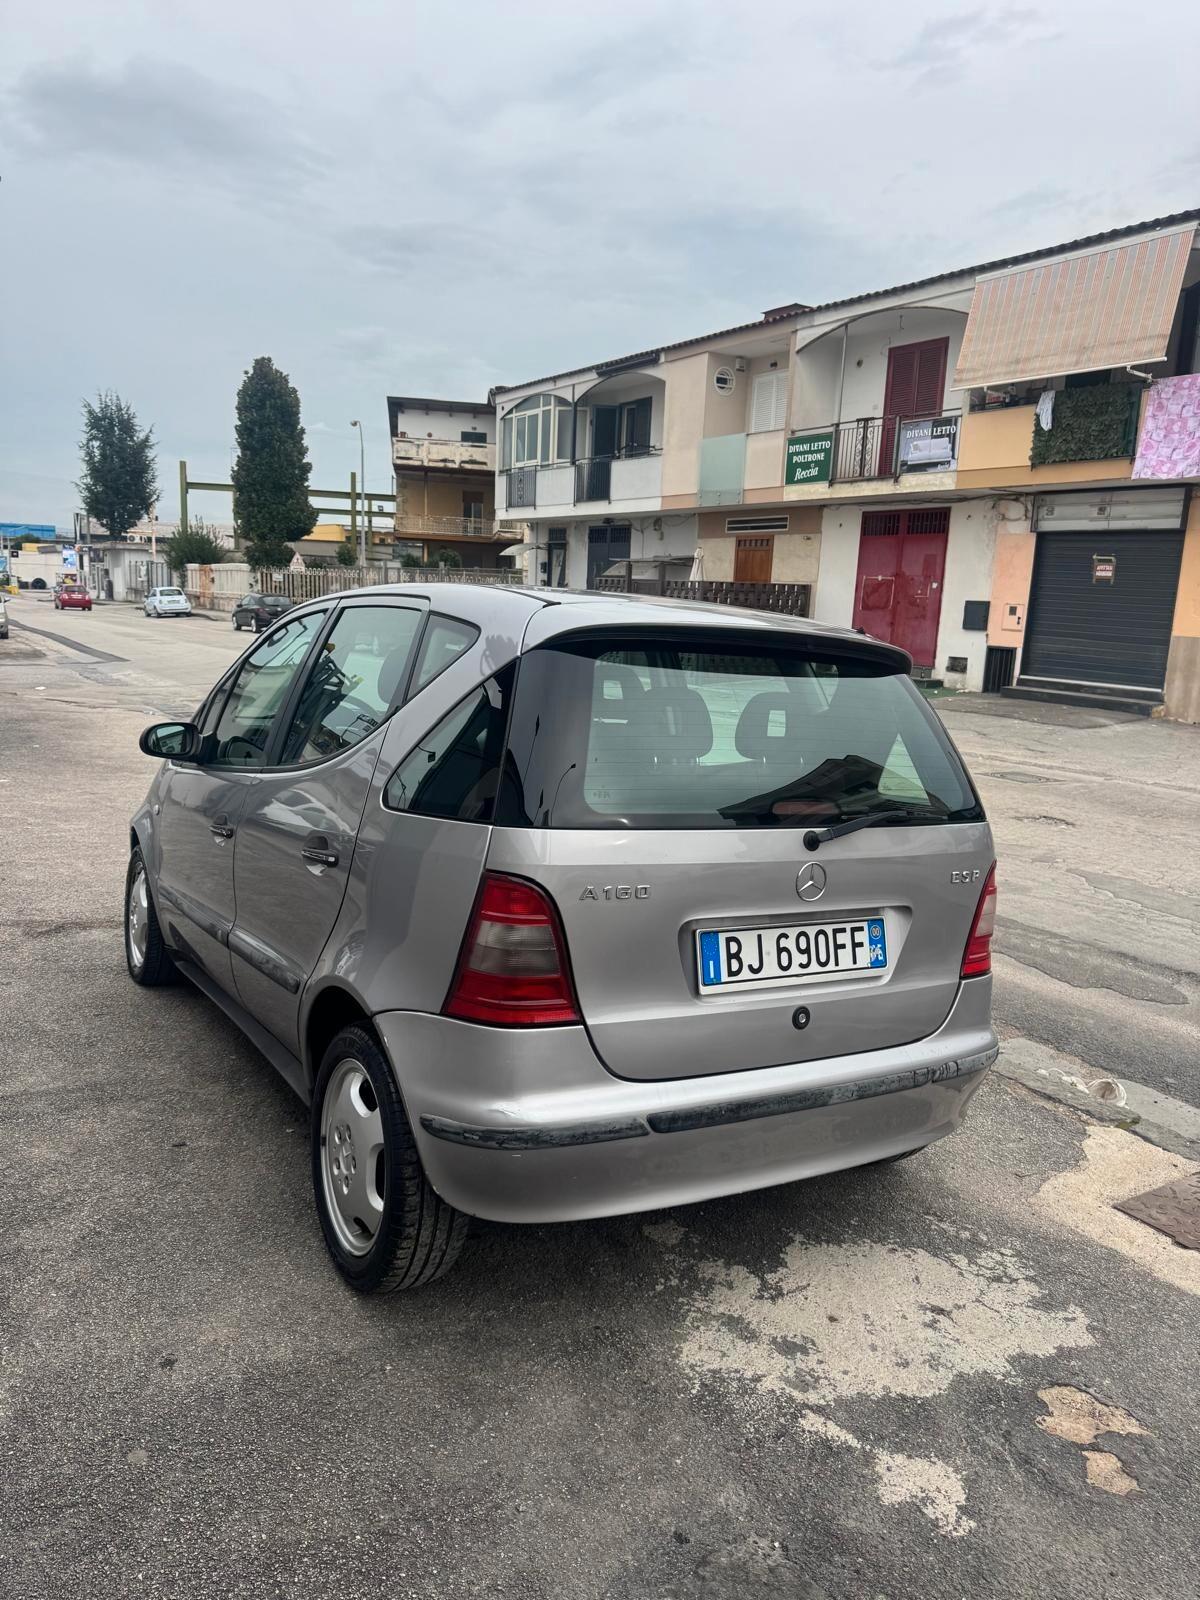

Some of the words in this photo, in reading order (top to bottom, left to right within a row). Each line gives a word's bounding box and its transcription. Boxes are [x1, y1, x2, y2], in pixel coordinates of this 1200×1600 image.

[906, 427, 931, 439] DIVANI
[932, 425, 957, 436] LETTO
[789, 443, 810, 453] DIVANI
[811, 441, 831, 450] LETTO
[792, 452, 825, 463] POLTRONE
[951, 870, 980, 884] ESP
[579, 885, 651, 900] A160
[725, 933, 764, 977] BJ
[776, 926, 865, 972] 690FF
